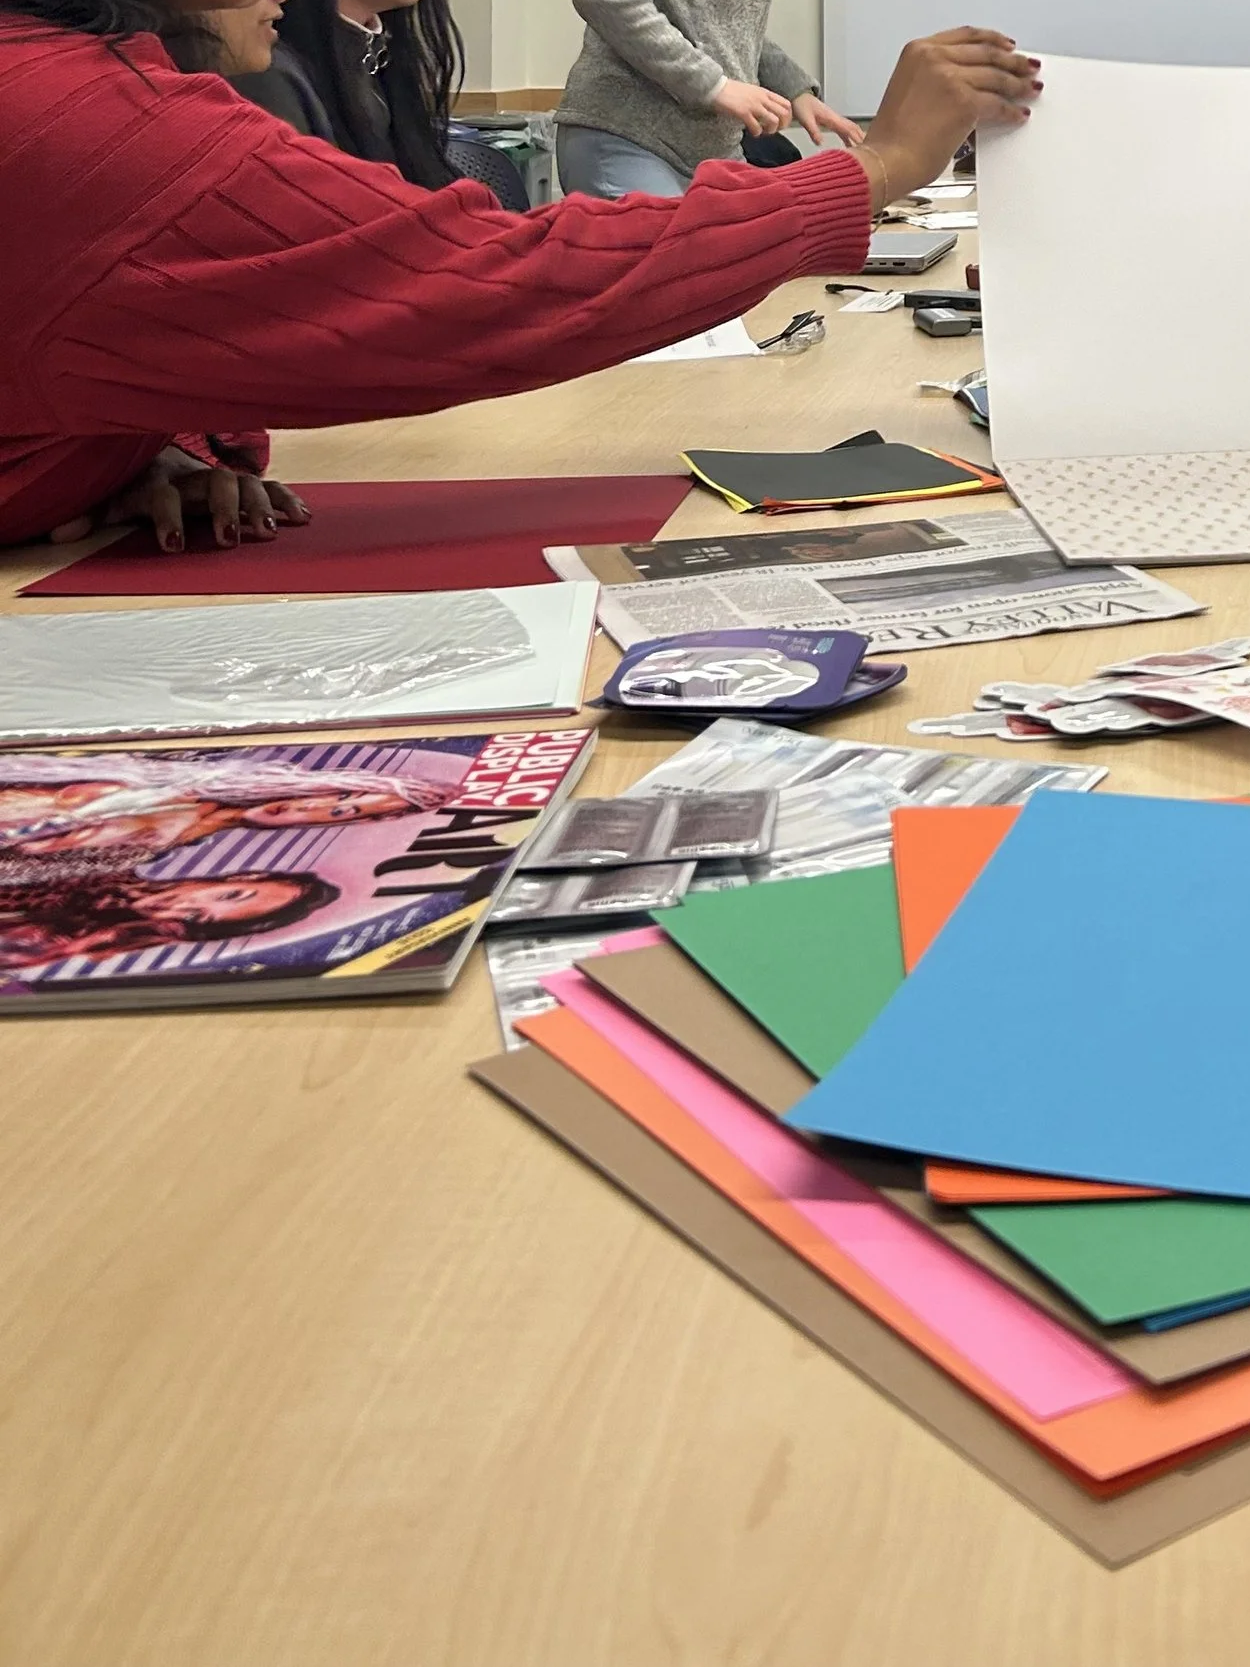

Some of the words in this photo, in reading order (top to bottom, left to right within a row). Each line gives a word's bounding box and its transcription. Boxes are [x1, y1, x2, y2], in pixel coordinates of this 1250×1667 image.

[1022, 582, 1143, 601] Applications
[935, 605, 964, 615] for
[967, 596, 1019, 609] open
[793, 618, 852, 629] flood
[962, 599, 1151, 634] VALLEY
[493, 728, 590, 806] PUBLIC
[371, 807, 543, 903] ART
